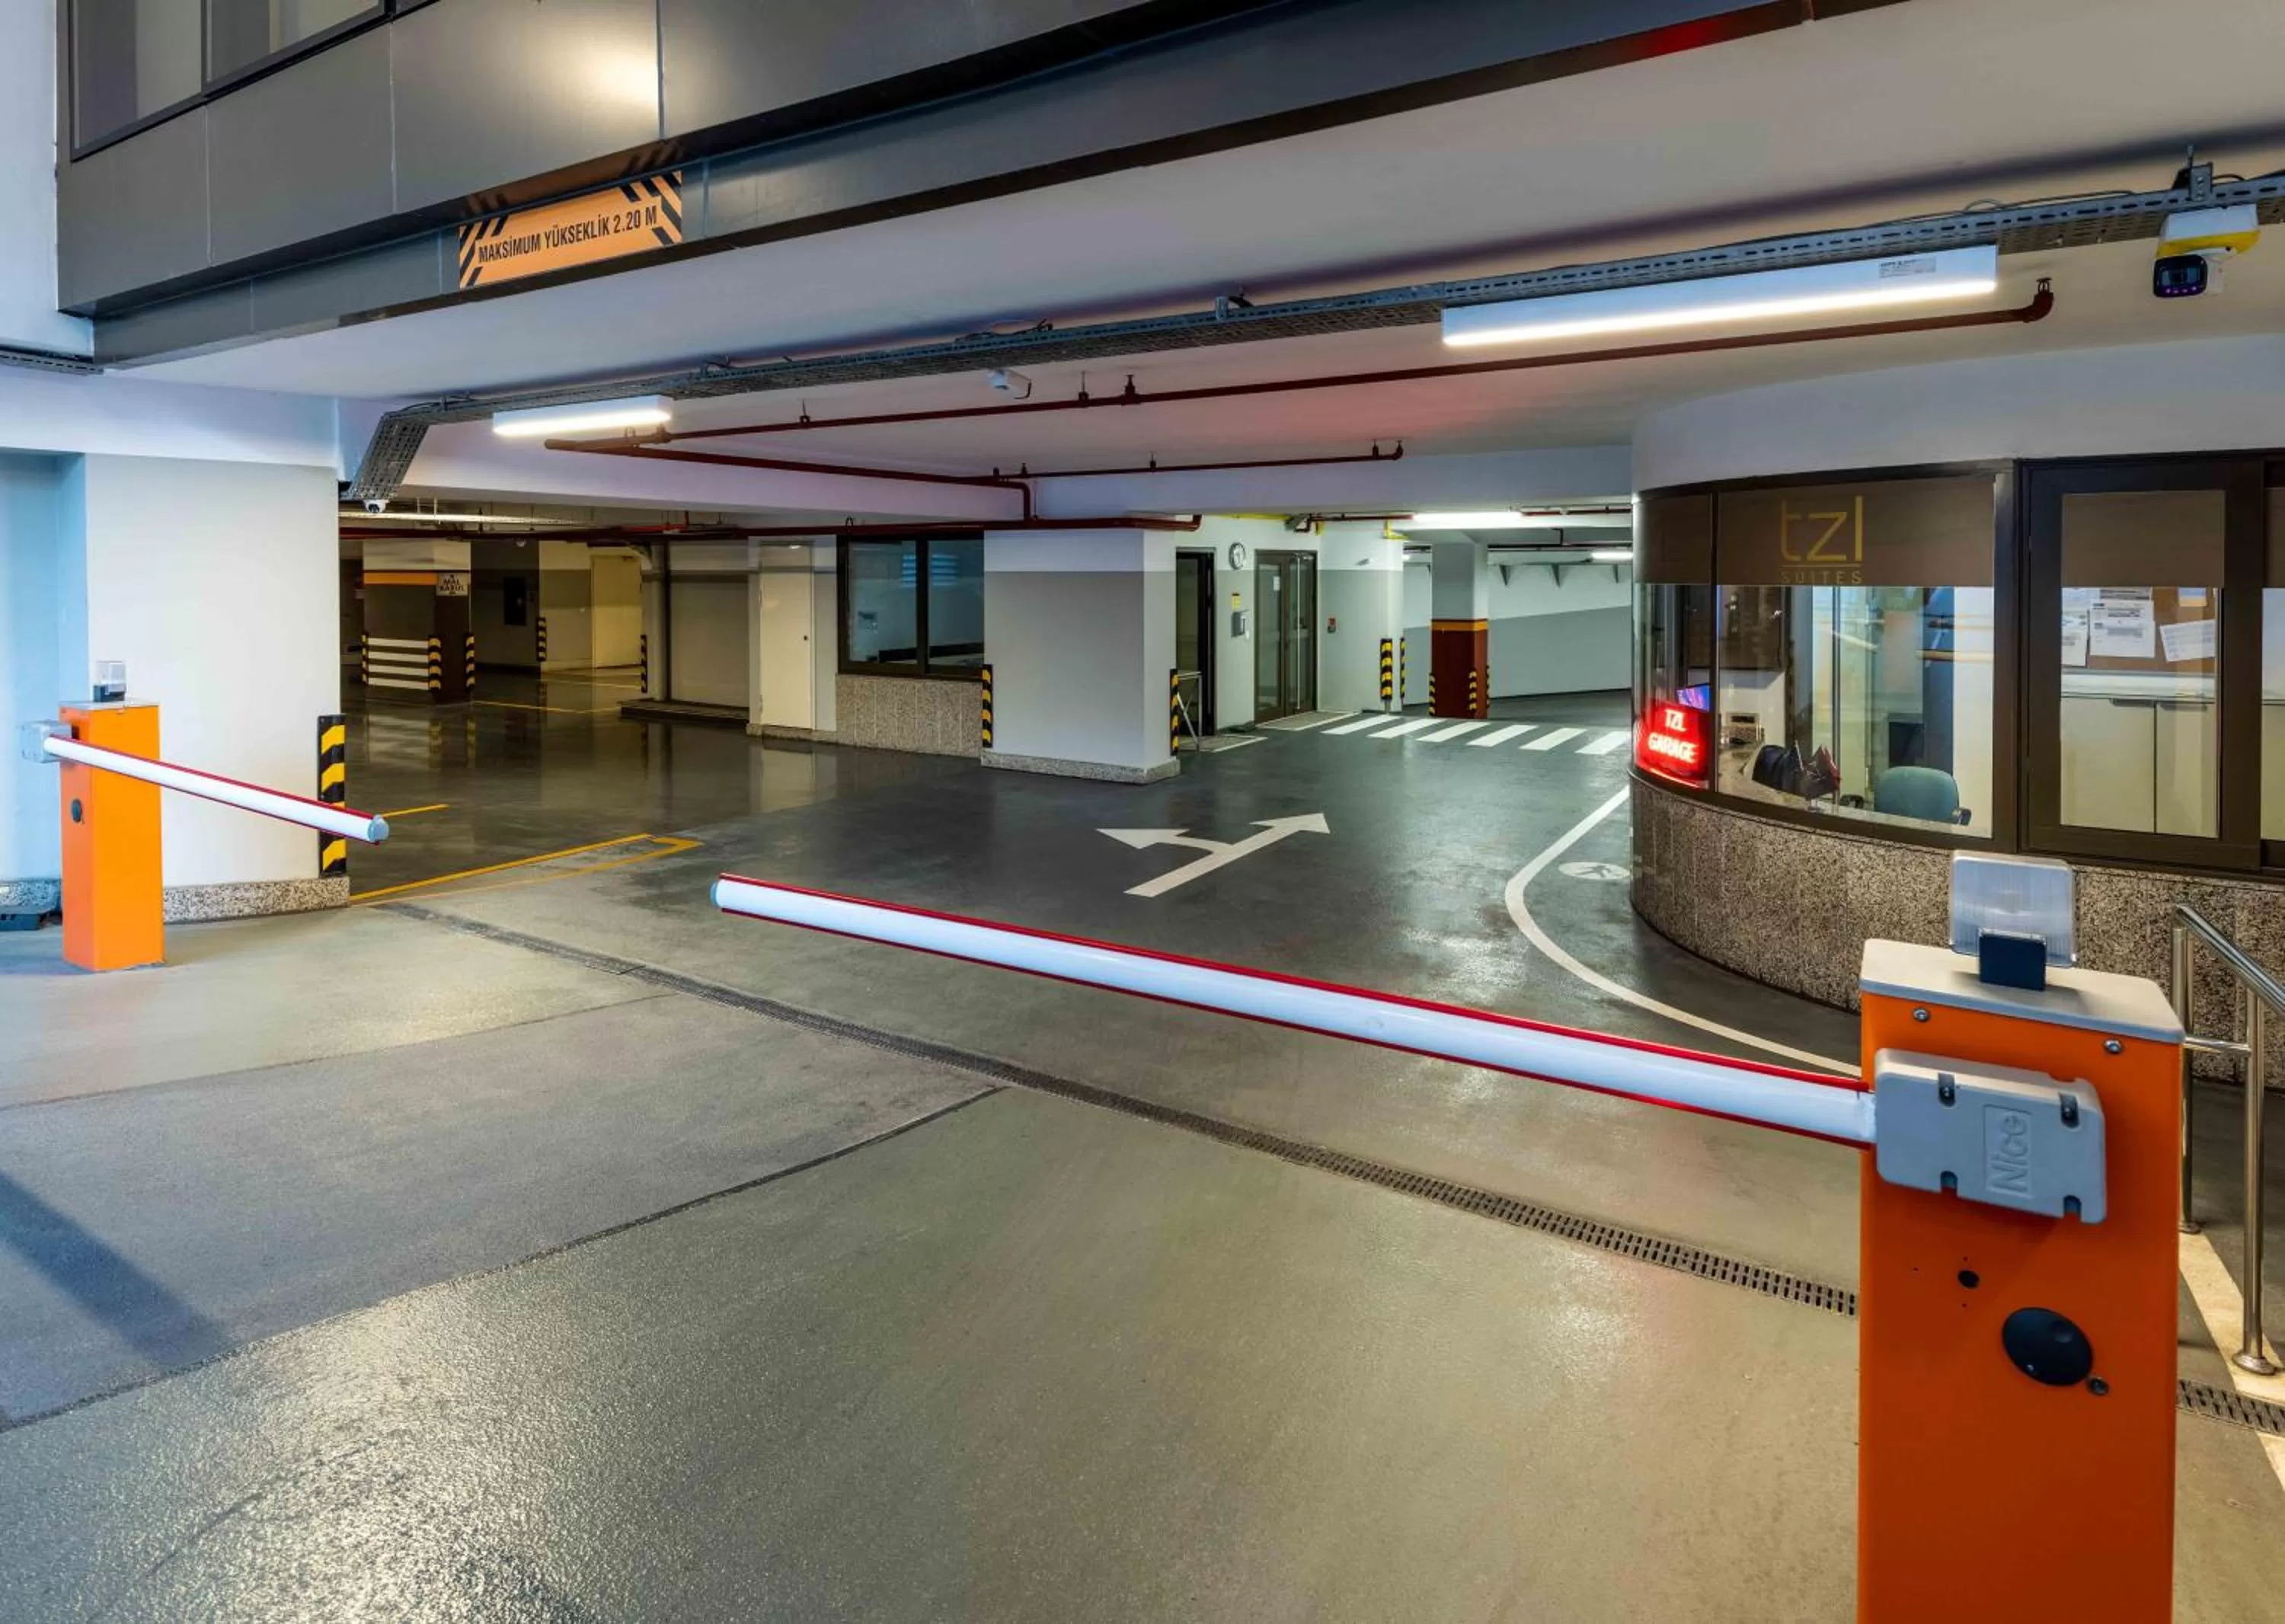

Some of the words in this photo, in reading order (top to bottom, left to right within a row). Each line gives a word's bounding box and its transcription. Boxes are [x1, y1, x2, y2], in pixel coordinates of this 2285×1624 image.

[478, 232, 542, 263] MAKSİMUM
[544, 213, 610, 249] YÜKSEKLİK
[613, 209, 641, 234] 2.20
[645, 205, 657, 226] M
[1782, 571, 1863, 584] SUITES
[1647, 732, 1699, 764] GARAGE
[1988, 1114, 2030, 1194] Nice
